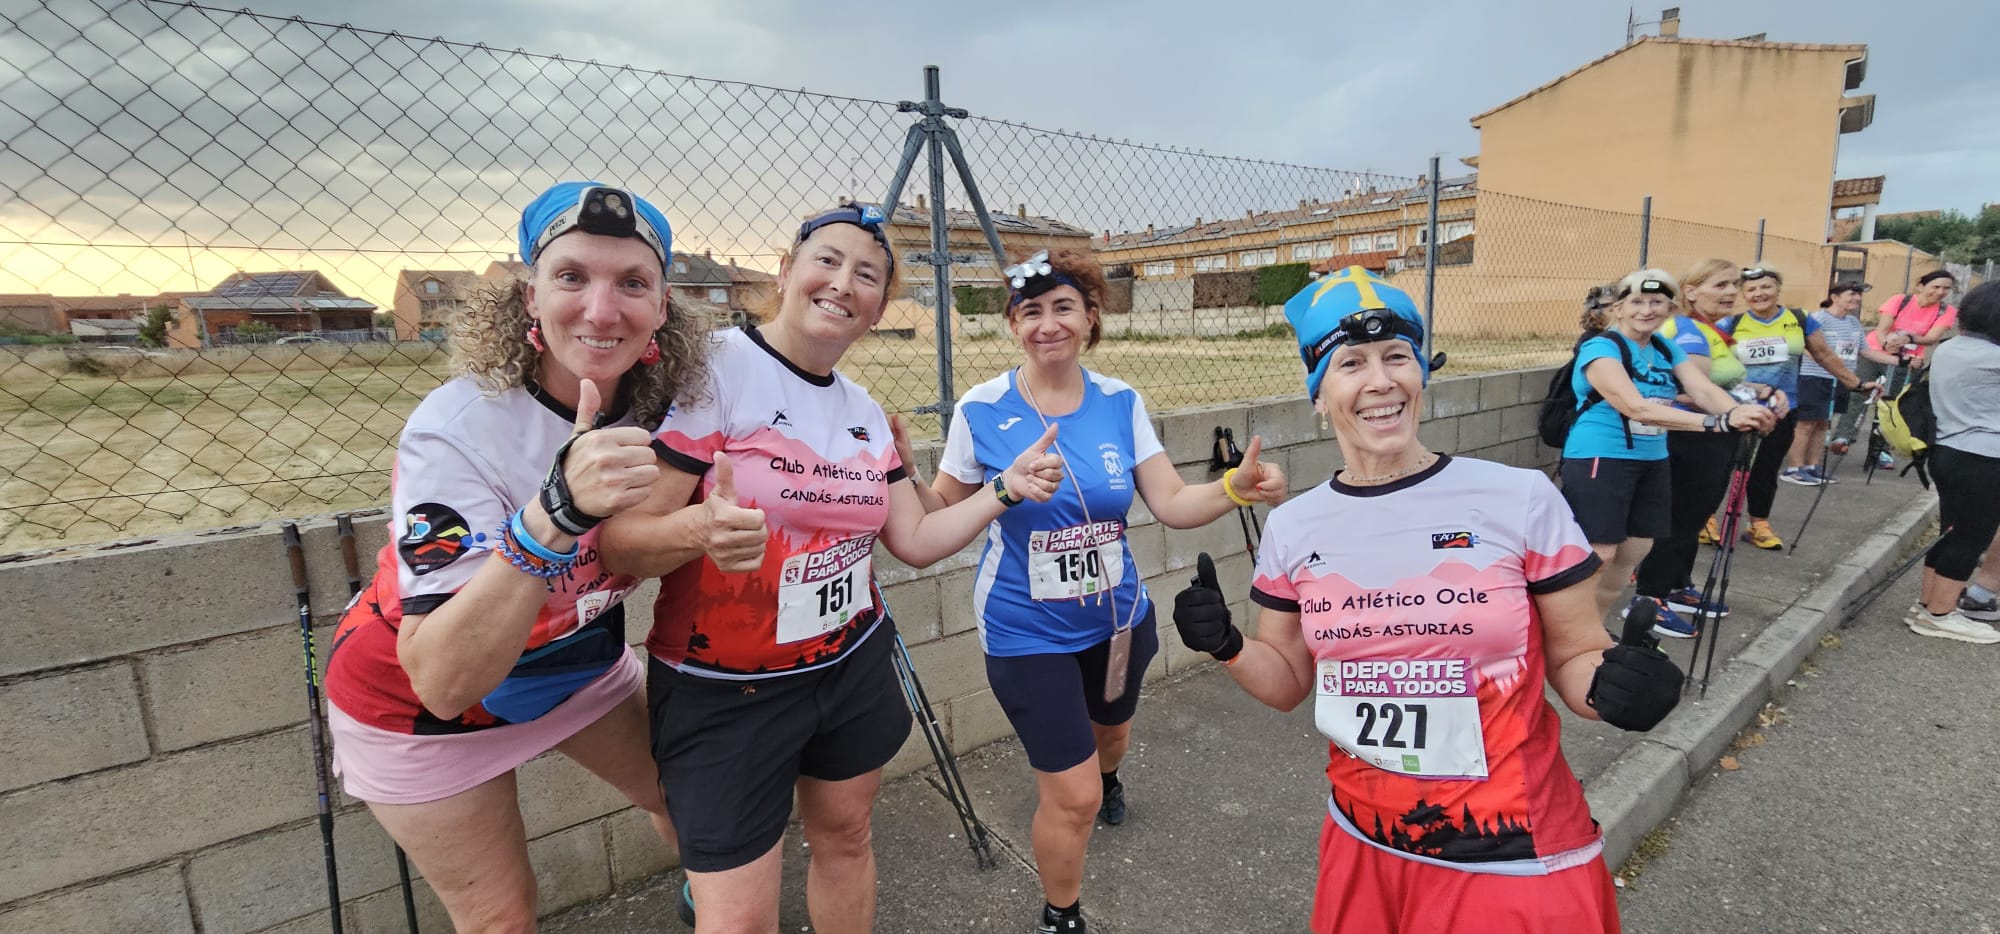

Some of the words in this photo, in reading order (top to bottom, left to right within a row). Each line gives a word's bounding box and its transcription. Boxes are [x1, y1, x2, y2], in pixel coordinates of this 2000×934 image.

[1749, 346, 1775, 359] 236
[770, 457, 805, 475] Club
[813, 463, 862, 481] Atlético
[780, 489, 884, 506] CANDÁS-ASTURIAS
[1050, 520, 1120, 542] DEPORTE
[1050, 540, 1081, 551] PARA
[1084, 531, 1119, 547] TODOS
[575, 547, 597, 568] lub
[807, 536, 876, 569] DEPORTE
[807, 561, 840, 580] PARA
[841, 545, 871, 568] TODOS
[1054, 549, 1099, 582] 150
[816, 570, 853, 618] 151
[1304, 597, 1332, 615] Club
[1341, 591, 1426, 611] Atlético
[1436, 588, 1489, 605] Ocle
[1314, 623, 1474, 641] CANDÁS-ASTURIAS
[1343, 659, 1465, 679] DEPORTE
[1345, 681, 1389, 694] PARA
[1395, 680, 1467, 695] TODOS
[1356, 702, 1428, 749] 227
